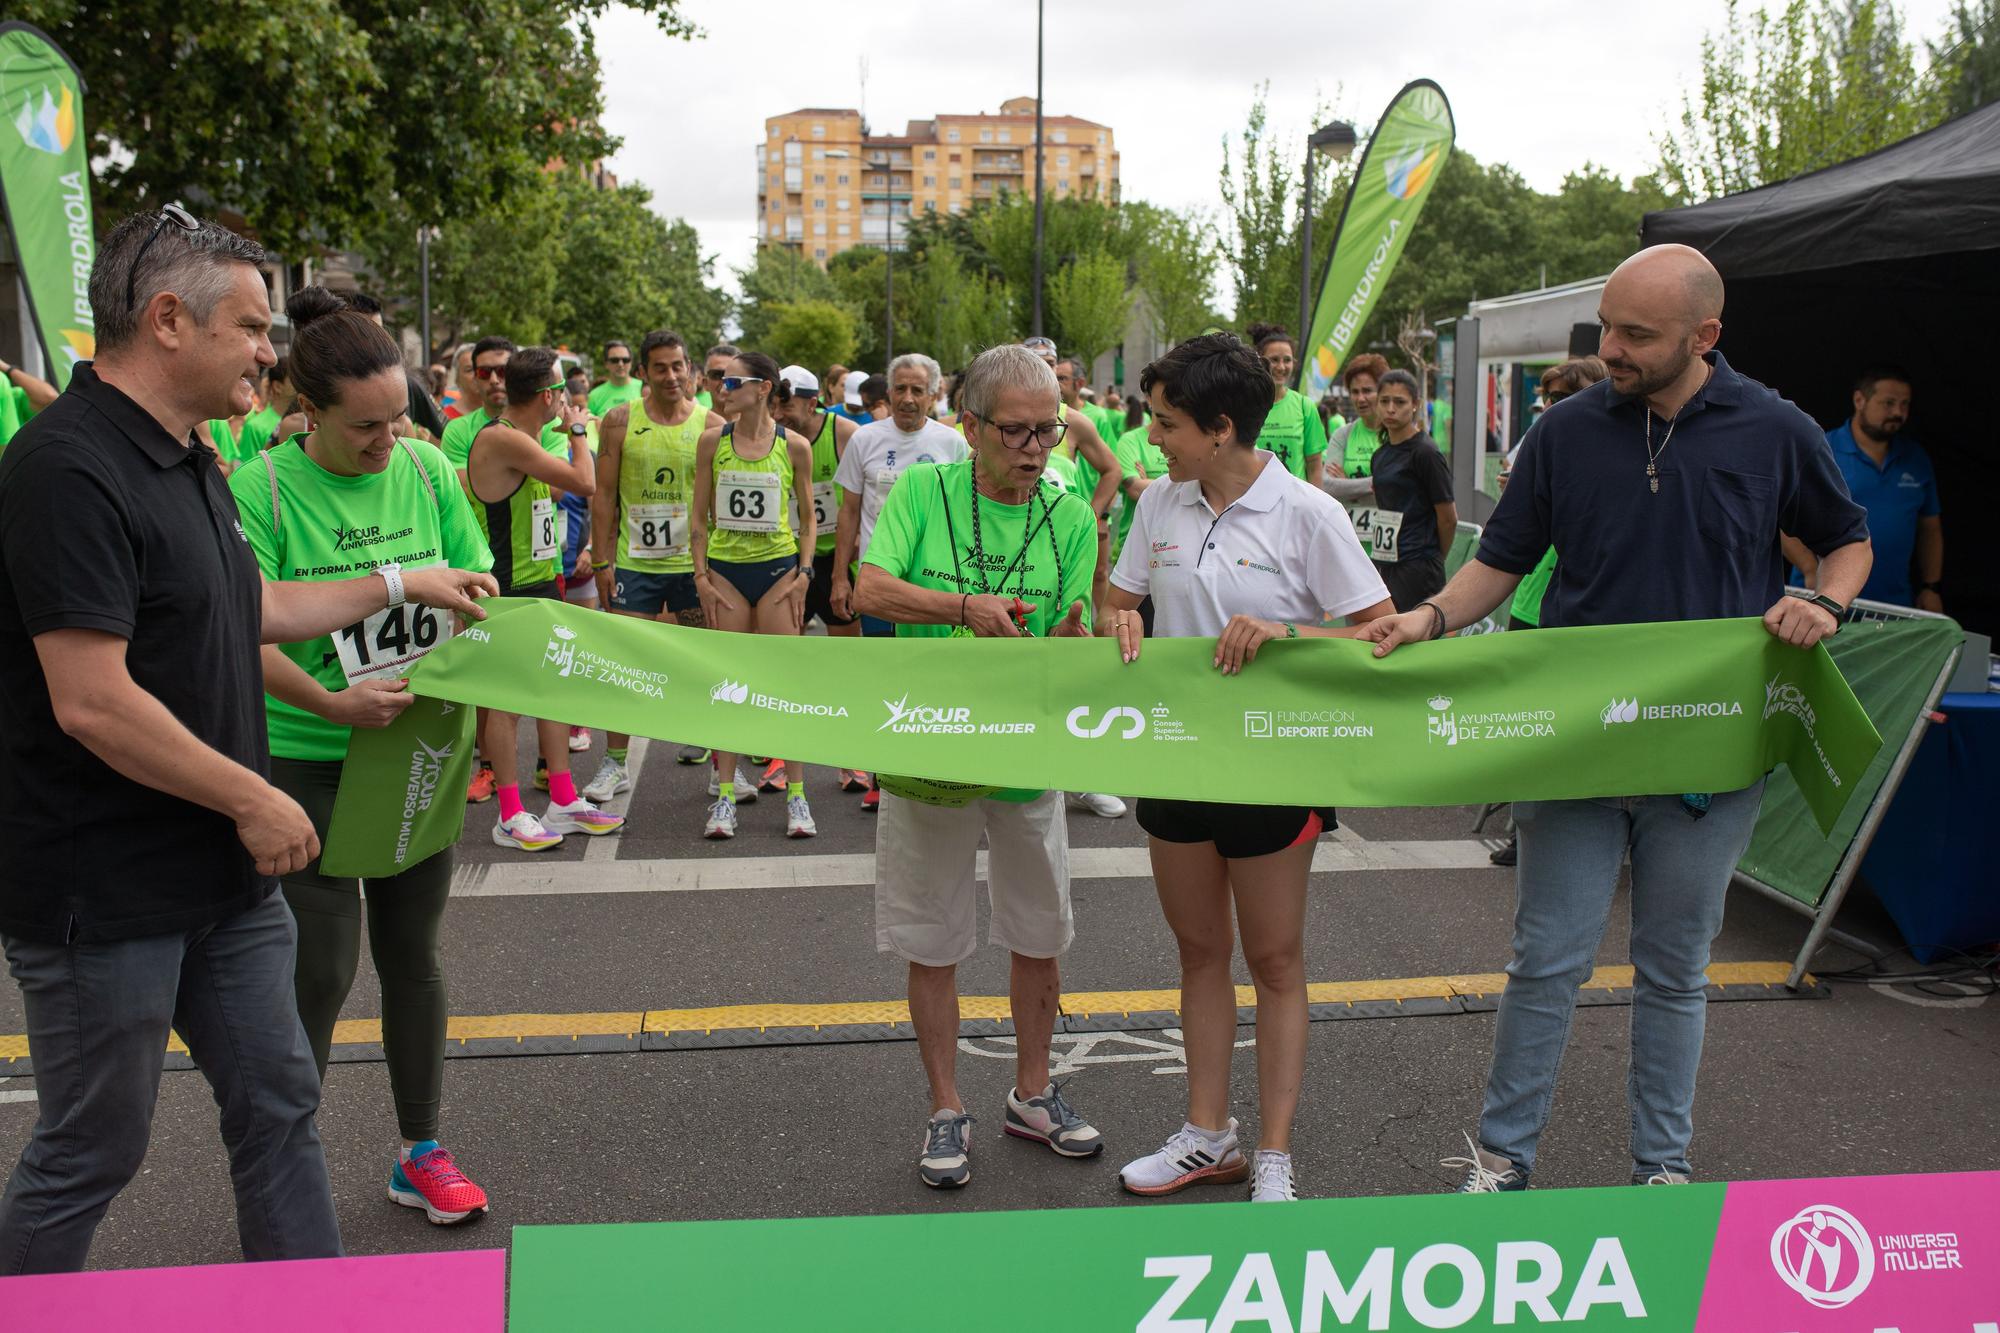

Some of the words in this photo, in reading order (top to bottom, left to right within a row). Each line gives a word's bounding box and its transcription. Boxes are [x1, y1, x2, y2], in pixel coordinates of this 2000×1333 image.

[59, 171, 95, 327] IBERDROLA
[1328, 218, 1402, 352] IBERDROLA
[641, 489, 682, 500] Adarsa
[729, 489, 765, 519] 63
[341, 535, 386, 552] UNIVERSO
[386, 527, 413, 542] MUJER
[347, 526, 380, 541] TOUR
[642, 520, 671, 547] 81
[294, 567, 310, 577] EN
[311, 563, 351, 576] FORMA
[355, 560, 378, 571] POR
[394, 548, 437, 564] IGUALDAD
[922, 568, 936, 578] EN
[967, 561, 1007, 573] UNVERSO
[341, 604, 438, 666] 146
[457, 627, 492, 644] VEN
[575, 650, 669, 685] AYUNTAMIENTO
[572, 661, 593, 679] DE
[597, 668, 665, 700] ZAMORA
[750, 692, 849, 718] IBERDROLA
[907, 706, 971, 724] TOUR
[1277, 709, 1355, 723] FUNDACIÓN
[1459, 710, 1556, 725] AYUNTAMIENTO
[1642, 701, 1743, 720] IBERDROLA
[1772, 684, 1816, 727] TOUR
[891, 722, 977, 735] UNIVERSO
[979, 722, 1036, 735] MUJER
[1164, 734, 1199, 742] Deportes
[1277, 726, 1330, 738] DEPORTE
[1332, 725, 1374, 738] JOVEN
[1459, 726, 1480, 741] DE
[1484, 723, 1556, 739] ZAMORA
[1764, 701, 1814, 739] UNIVERSO
[1813, 739, 1842, 788] MUJER
[402, 751, 425, 819] UNIVERSO
[417, 760, 442, 811] TOUR
[394, 821, 411, 864] MUJER
[1878, 1232, 1959, 1250] UNIVERSO
[1883, 1249, 1963, 1272] MUJER
[1135, 1236, 1649, 1333] ZAMORA
